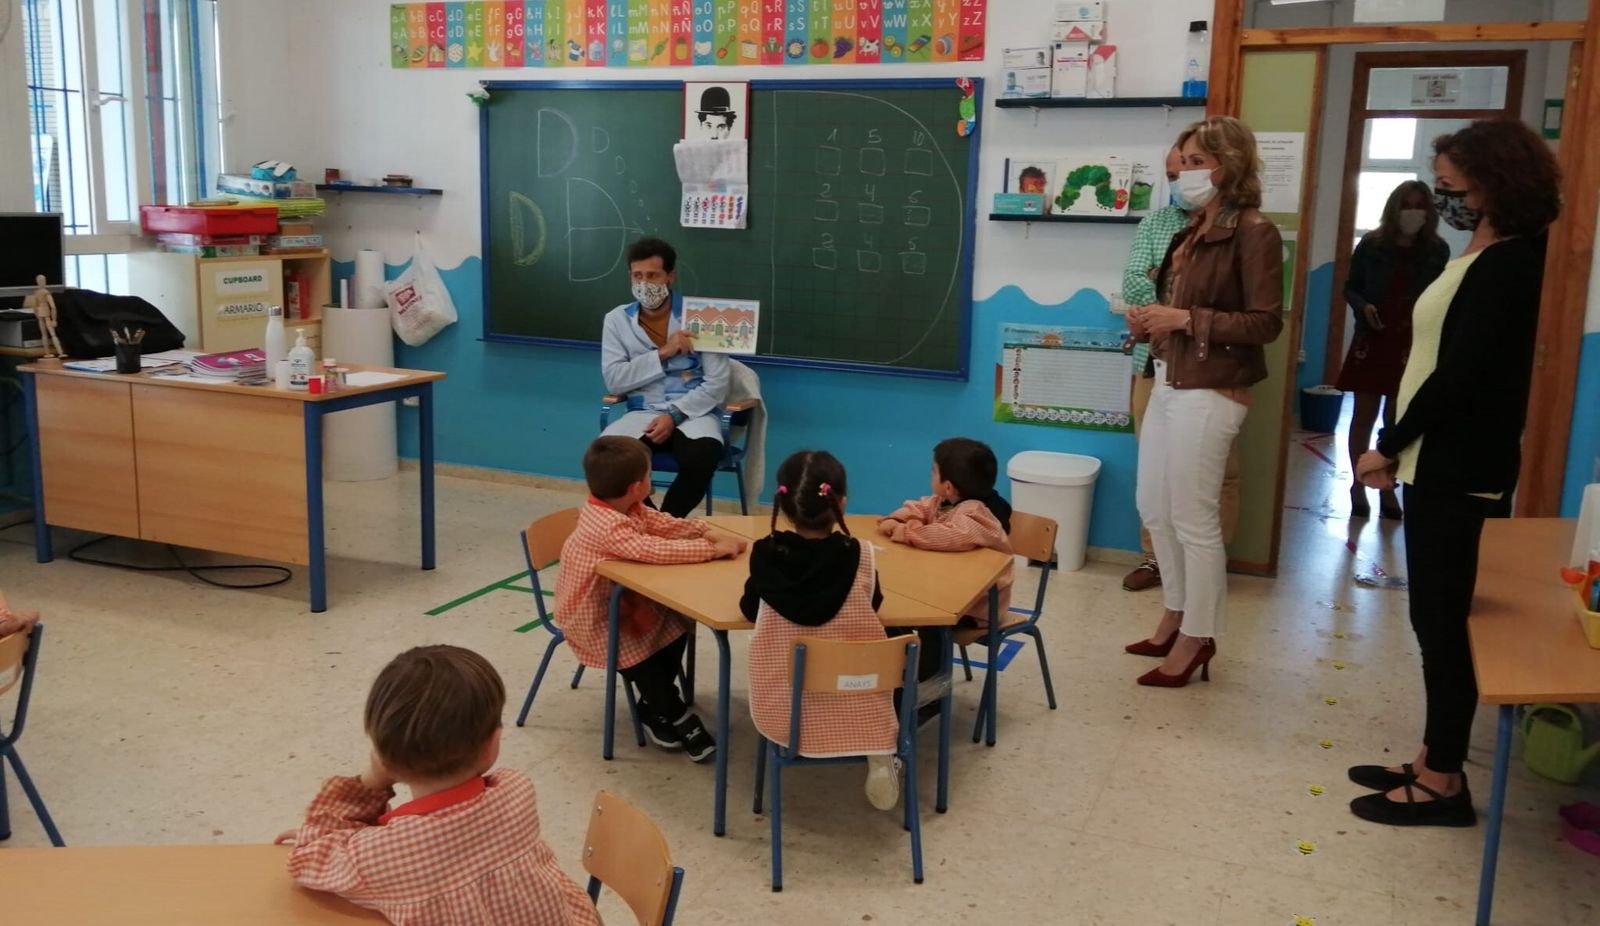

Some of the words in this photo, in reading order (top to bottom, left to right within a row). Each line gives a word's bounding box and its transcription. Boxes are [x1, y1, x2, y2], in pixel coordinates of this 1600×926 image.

[429, 10, 443, 22] cC
[448, 9, 463, 21] dD
[506, 8, 522, 24] gG
[527, 8, 542, 19] hH
[588, 6, 604, 18] kK
[611, 5, 624, 17] lL
[628, 4, 647, 17] mM
[651, 4, 668, 16] nN
[695, 2, 712, 15] oO
[718, 1, 735, 19] pP
[740, 0, 758, 18] qQ
[430, 26, 444, 38] cC
[448, 26, 464, 38] dD
[506, 24, 523, 38] gG
[527, 24, 542, 36] hH
[589, 22, 605, 34] kK
[612, 22, 624, 34] lL
[629, 22, 648, 34] mM
[652, 22, 669, 33] nN
[674, 18, 691, 32] ñÑ
[696, 19, 712, 32] oO
[718, 19, 736, 34] pP
[740, 18, 760, 33] qQ
[768, 18, 782, 30] rR
[790, 18, 805, 30] sS
[814, 16, 828, 30] tT
[835, 16, 854, 28] uU
[861, 16, 880, 28] vV
[884, 14, 907, 28] wW
[912, 14, 932, 26] xX
[938, 12, 958, 27] yY
[964, 12, 982, 25] zZ
[537, 106, 579, 178] D
[592, 126, 610, 154] D
[826, 127, 838, 142] 1
[868, 128, 882, 144] 5
[913, 130, 926, 146] 10
[820, 182, 832, 198] 2
[864, 183, 876, 202] 4
[509, 190, 547, 267] D
[864, 232, 873, 248] 4
[224, 275, 263, 285] CUPBOARD
[224, 302, 264, 314] ARMARIO
